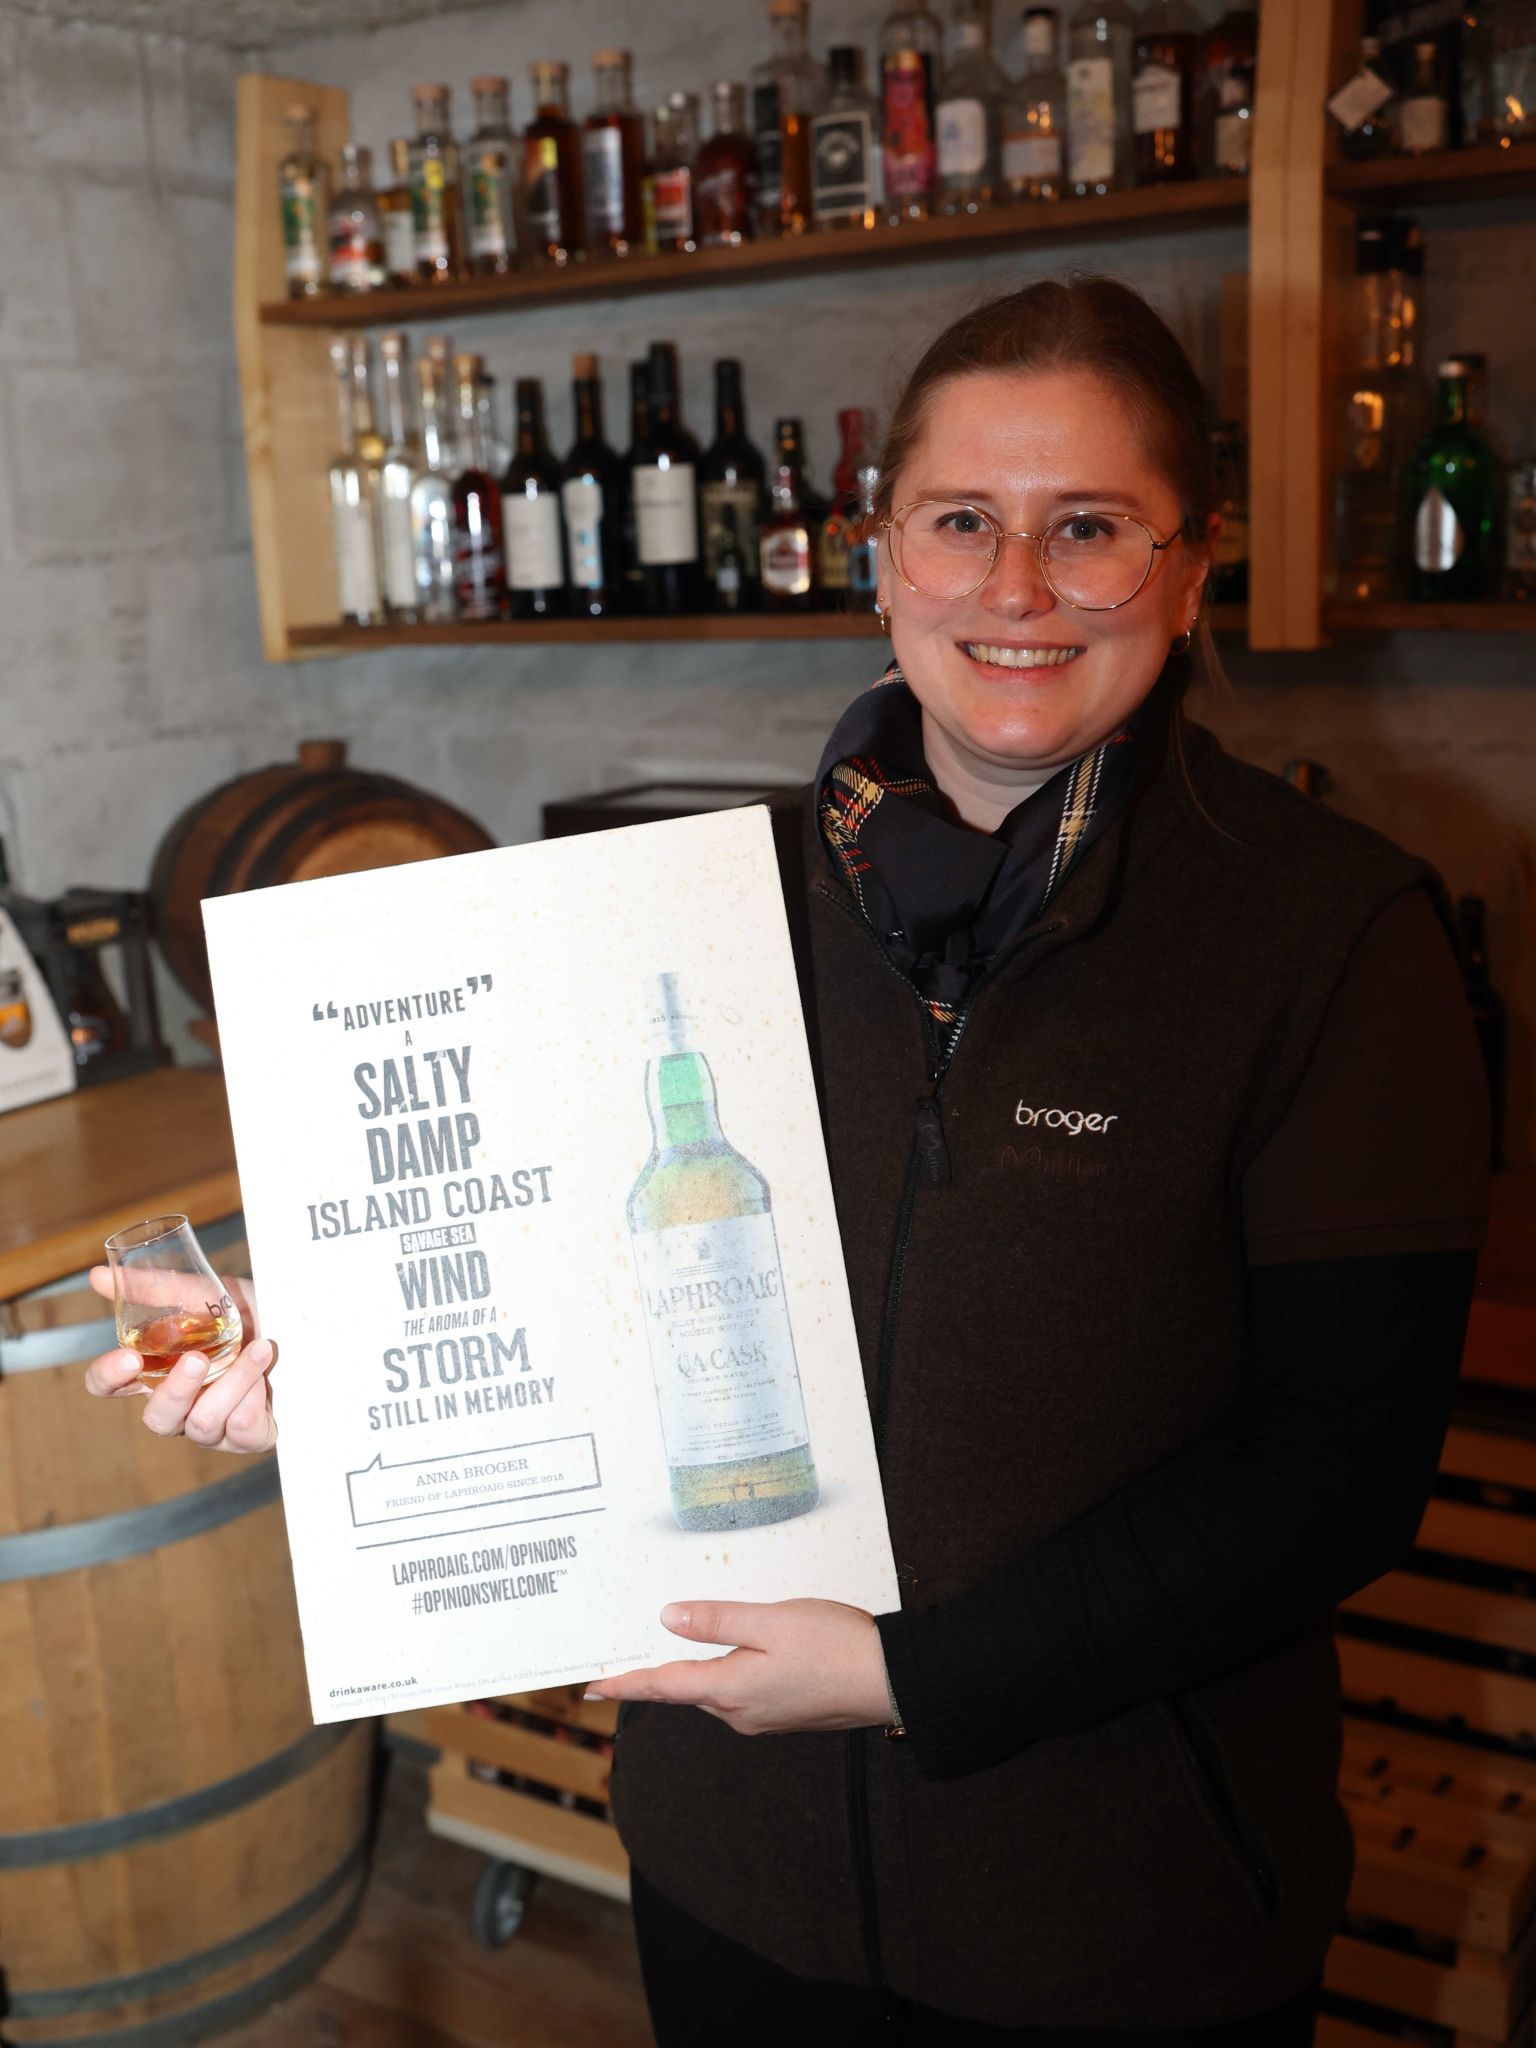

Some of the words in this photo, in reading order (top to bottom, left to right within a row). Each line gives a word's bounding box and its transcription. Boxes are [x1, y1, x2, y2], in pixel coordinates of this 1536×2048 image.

[405, 1030, 413, 1046] A
[353, 1045, 472, 1120] SALTY
[1015, 1099, 1118, 1135] broger
[365, 1112, 481, 1185] DAMP
[307, 1186, 432, 1241] ISLAND
[443, 1165, 553, 1218] COAST
[402, 1228, 449, 1252] SAVAGE
[451, 1225, 475, 1244] SEA
[395, 1249, 491, 1311] WIND
[404, 1318, 425, 1337] THE
[428, 1310, 469, 1334] AROMA
[472, 1307, 487, 1326] OF
[490, 1306, 497, 1323] A
[383, 1327, 532, 1393] STORM
[710, 1341, 768, 1370] CASK
[368, 1398, 429, 1431] STILL
[434, 1393, 459, 1420] IN
[464, 1376, 555, 1416] MEMORY
[416, 1470, 460, 1487] ANNA
[464, 1458, 529, 1479] BROGER
[385, 1494, 425, 1508] FRIEND
[427, 1492, 442, 1502] OF
[444, 1482, 505, 1500] LAPHROAIG
[507, 1476, 538, 1490] SINCE
[392, 1535, 578, 1586] LAPHROAIG.COM/OPINIONS
[329, 1676, 418, 1698] drinkaware.co.uk
